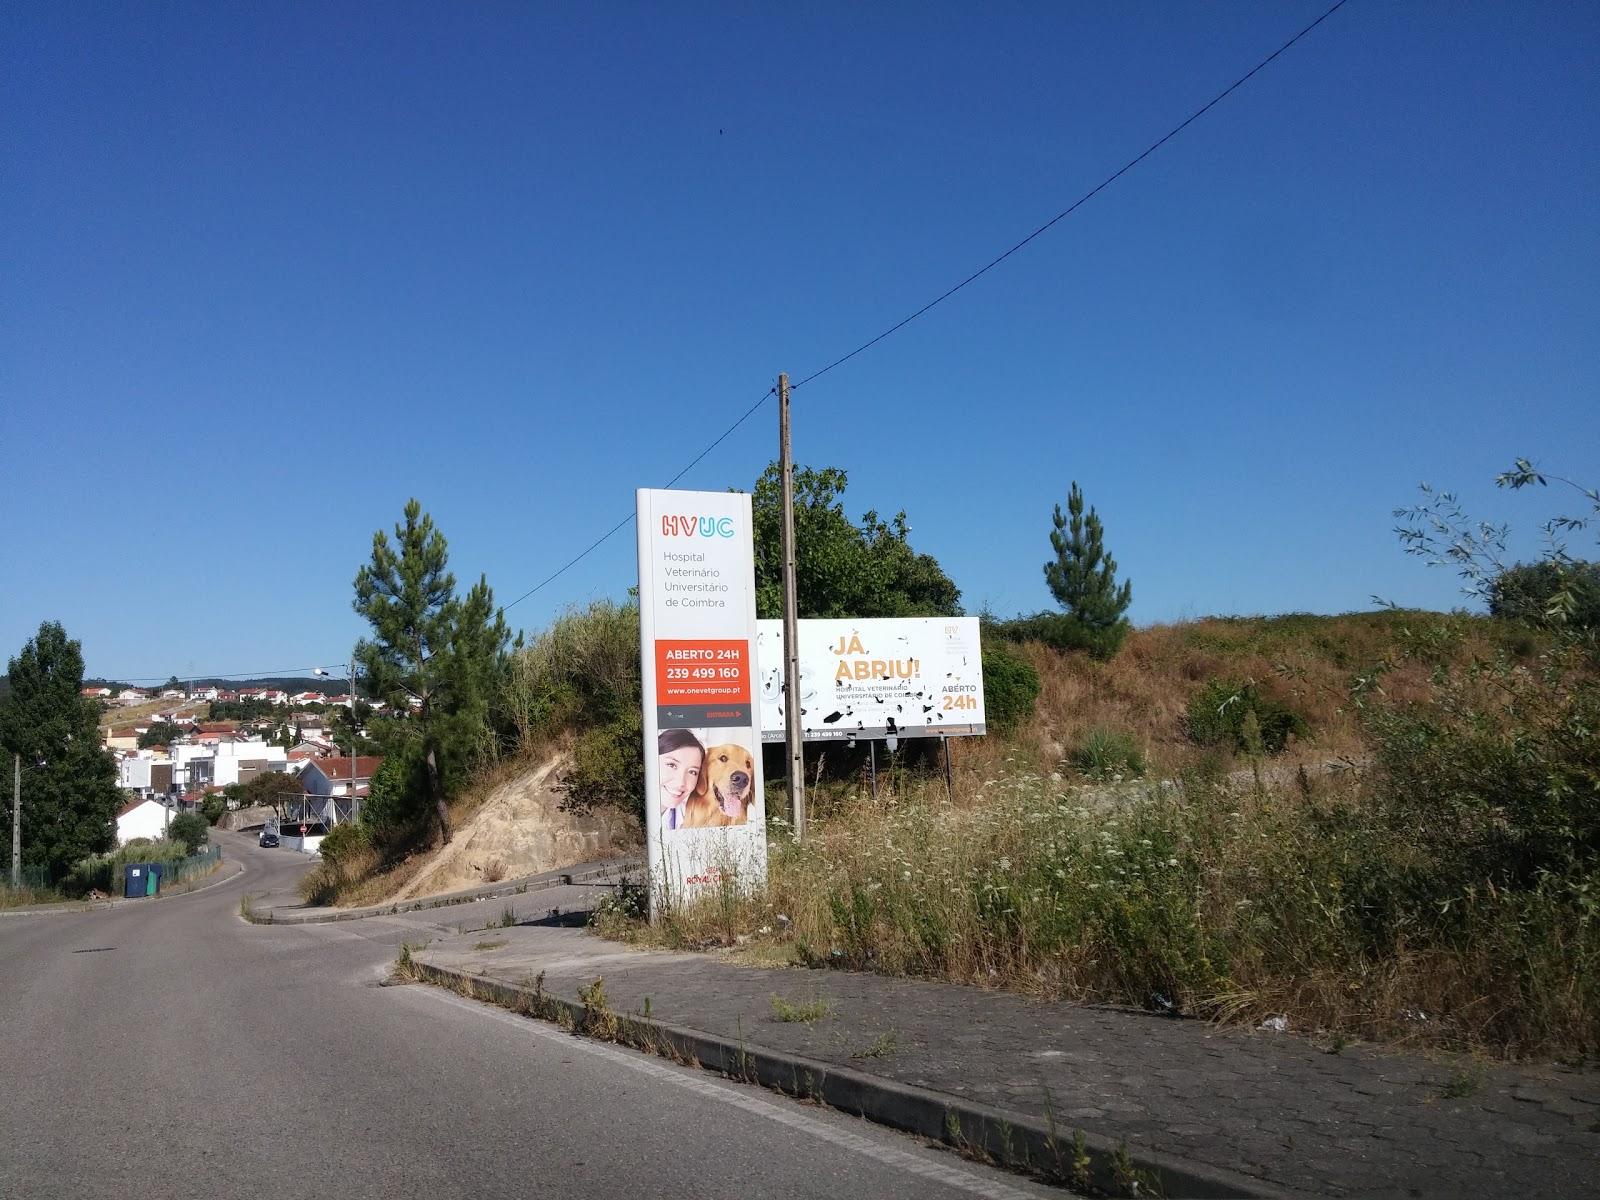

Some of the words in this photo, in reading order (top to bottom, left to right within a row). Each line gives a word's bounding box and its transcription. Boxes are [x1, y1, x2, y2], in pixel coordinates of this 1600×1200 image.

[662, 515, 734, 537] HVUC
[663, 551, 705, 563] Hospital
[664, 567, 720, 577] Veterinário
[664, 582, 729, 592] Universitário
[665, 597, 679, 607] de
[681, 597, 725, 608] Coimbra
[834, 630, 866, 656] JÁ
[666, 649, 714, 660] ABERTO
[717, 649, 740, 660] 24H
[666, 668, 689, 679] 239
[692, 668, 716, 679] 499
[718, 667, 740, 678] 160
[834, 659, 921, 680] ABRIU!
[667, 687, 741, 696] www.onevetgroup.pt
[943, 694, 977, 711] 24h
